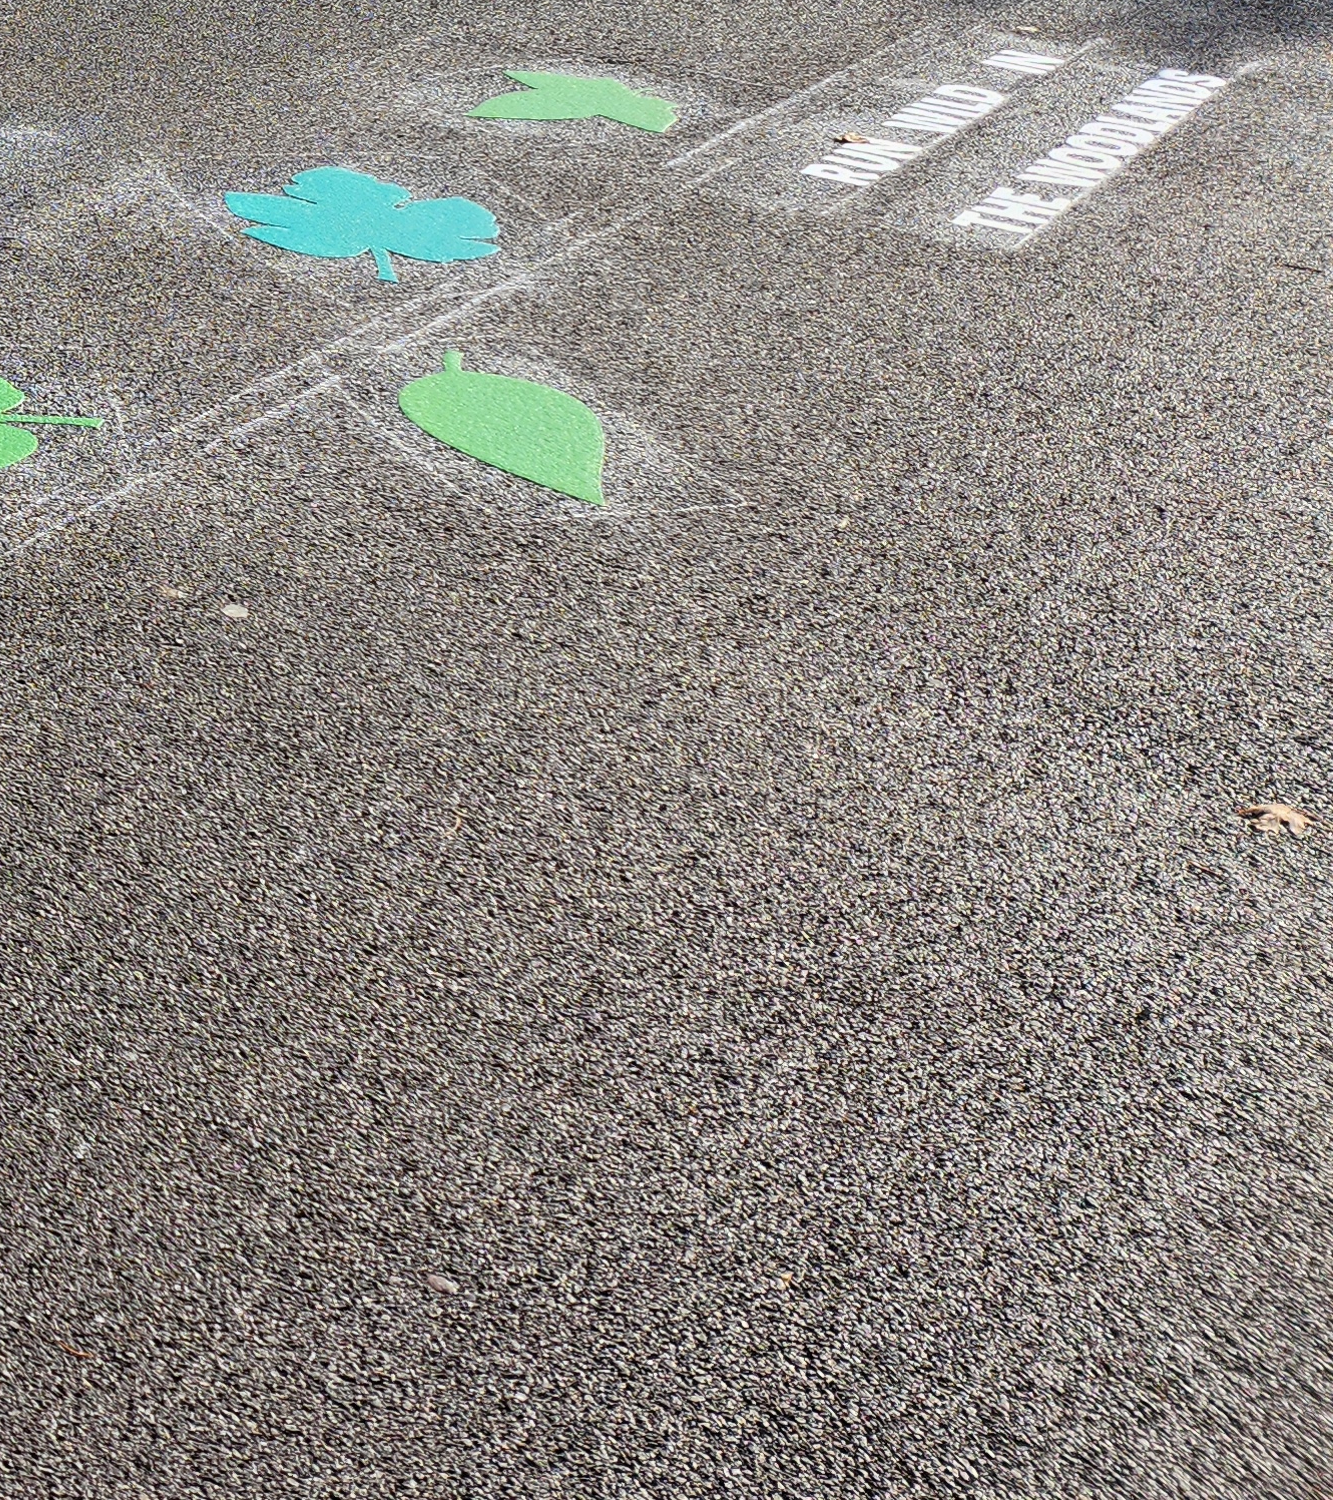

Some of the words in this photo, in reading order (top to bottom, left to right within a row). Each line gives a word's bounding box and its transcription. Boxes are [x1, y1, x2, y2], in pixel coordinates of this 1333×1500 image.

[800, 138, 924, 186] RUN
[881, 84, 1006, 133] WILD
[981, 49, 1066, 74] IN
[951, 186, 1072, 235] THE
[1015, 69, 1228, 187] WOODLANDS
